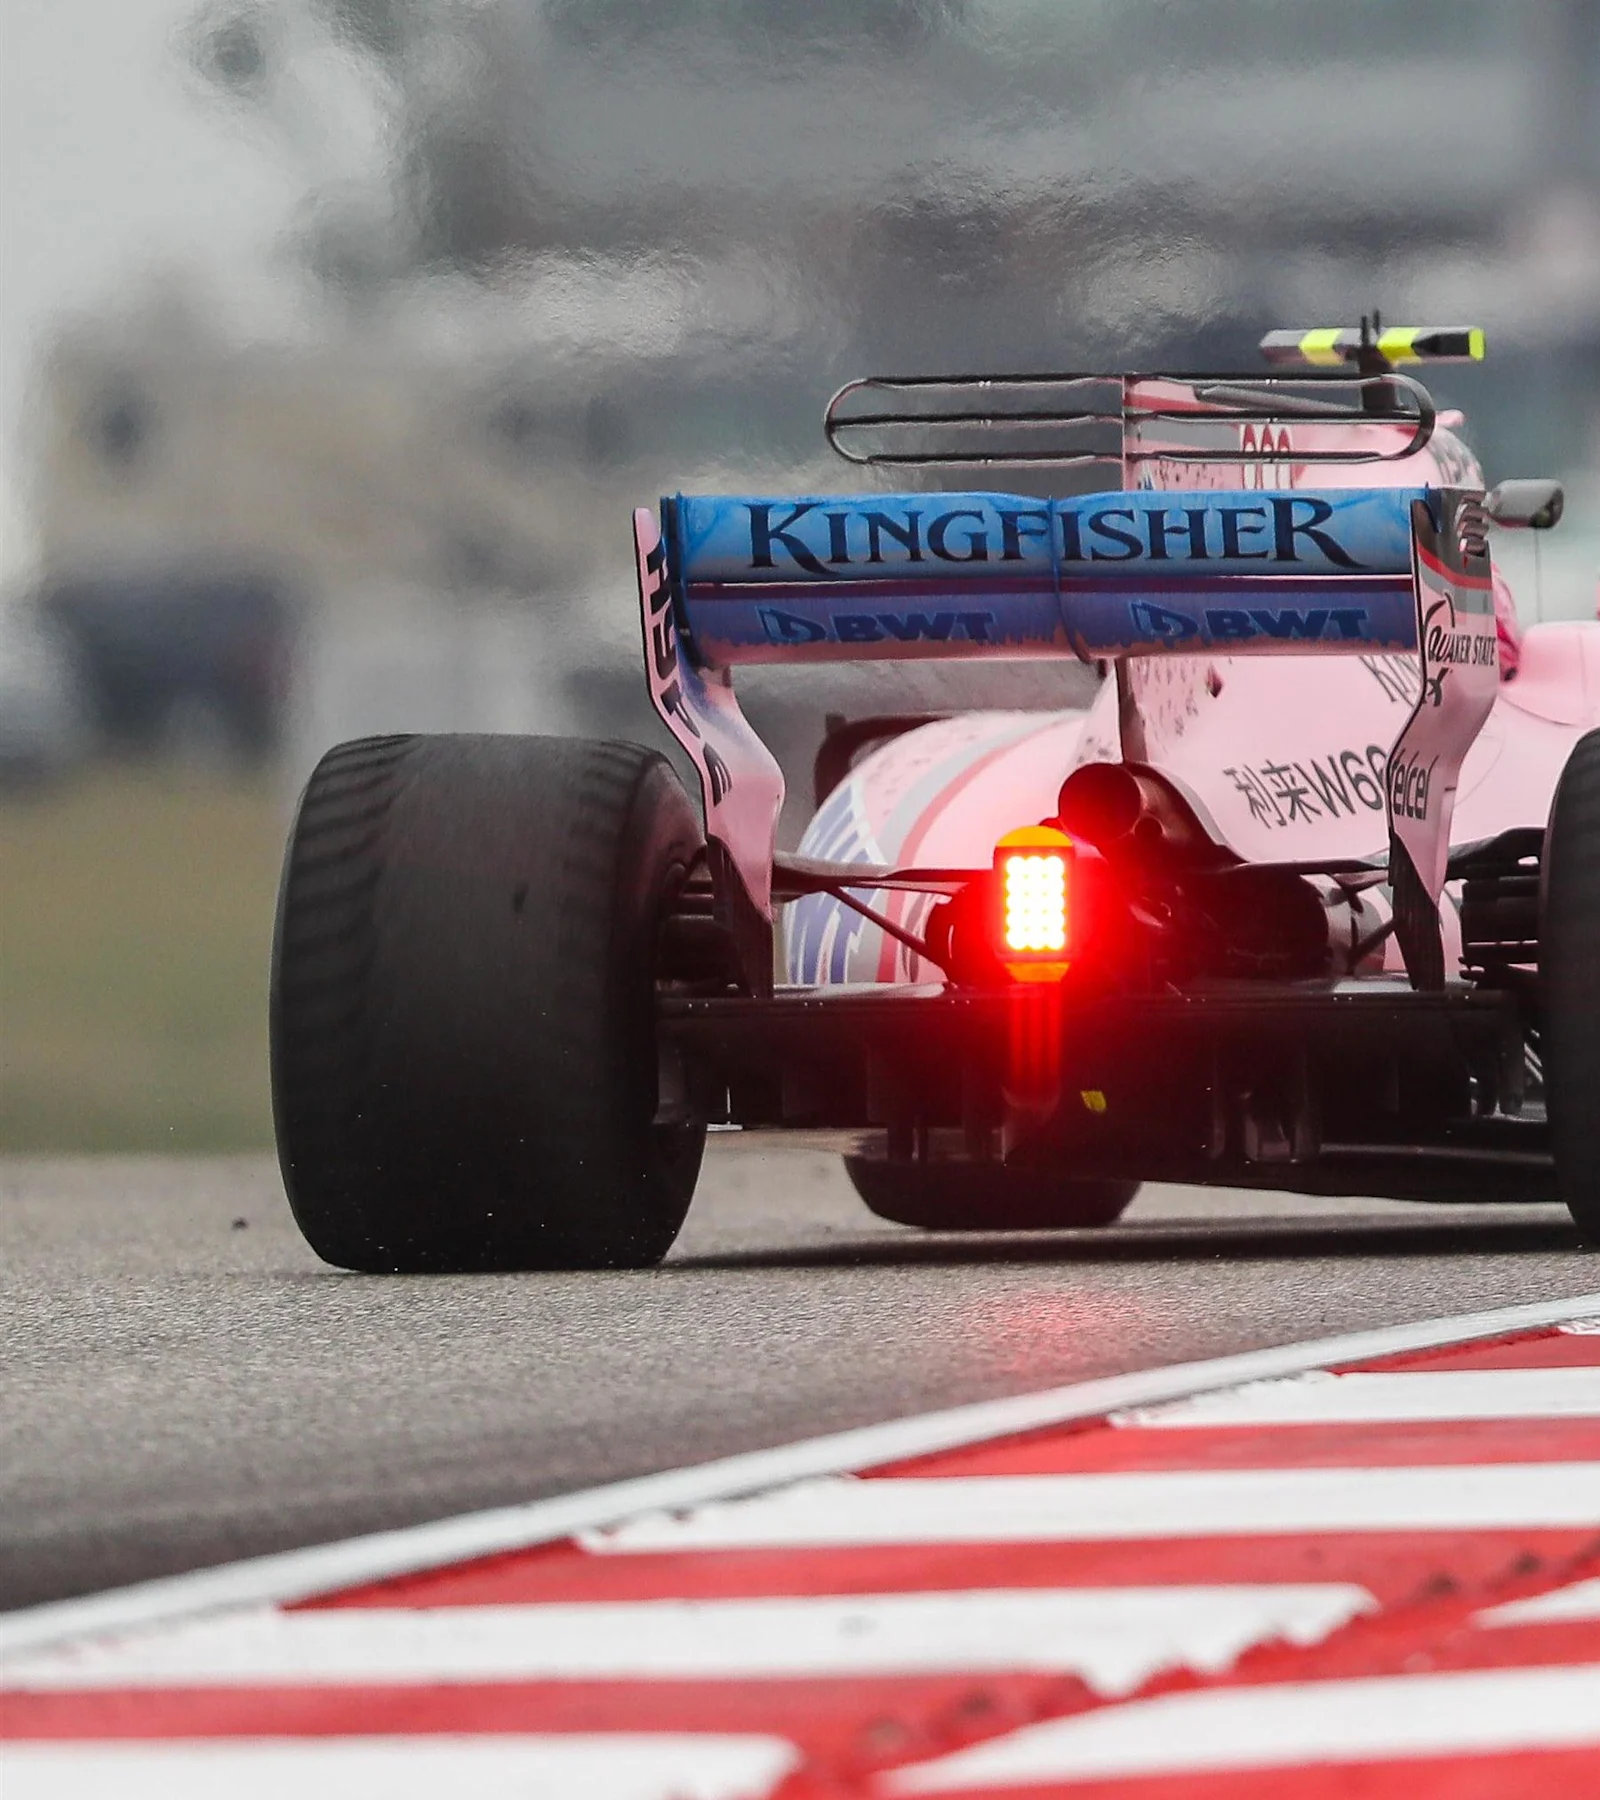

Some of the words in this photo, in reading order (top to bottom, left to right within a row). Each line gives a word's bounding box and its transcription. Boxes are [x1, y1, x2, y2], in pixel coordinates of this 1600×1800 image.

[744, 496, 1373, 577] KINGFISHER
[828, 610, 996, 643] BWT
[1203, 608, 1370, 641] BWT
[1472, 635, 1497, 667] STATE
